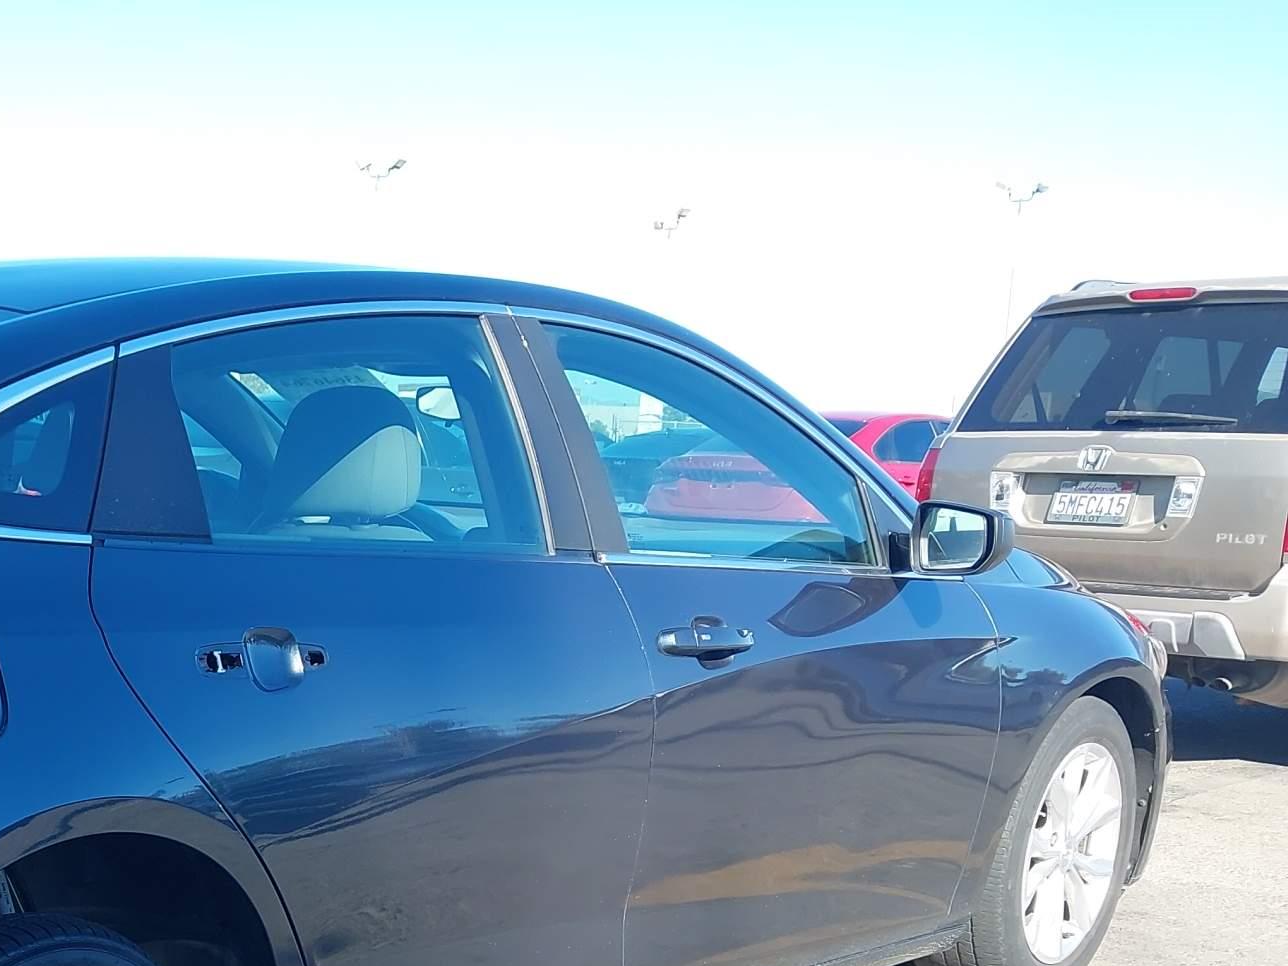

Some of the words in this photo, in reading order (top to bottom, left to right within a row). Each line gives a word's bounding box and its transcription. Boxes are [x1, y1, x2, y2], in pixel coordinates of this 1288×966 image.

[1056, 494, 1127, 516] 5MFC415
[1071, 514, 1102, 522] PILOT
[1215, 532, 1268, 545] PILOT
